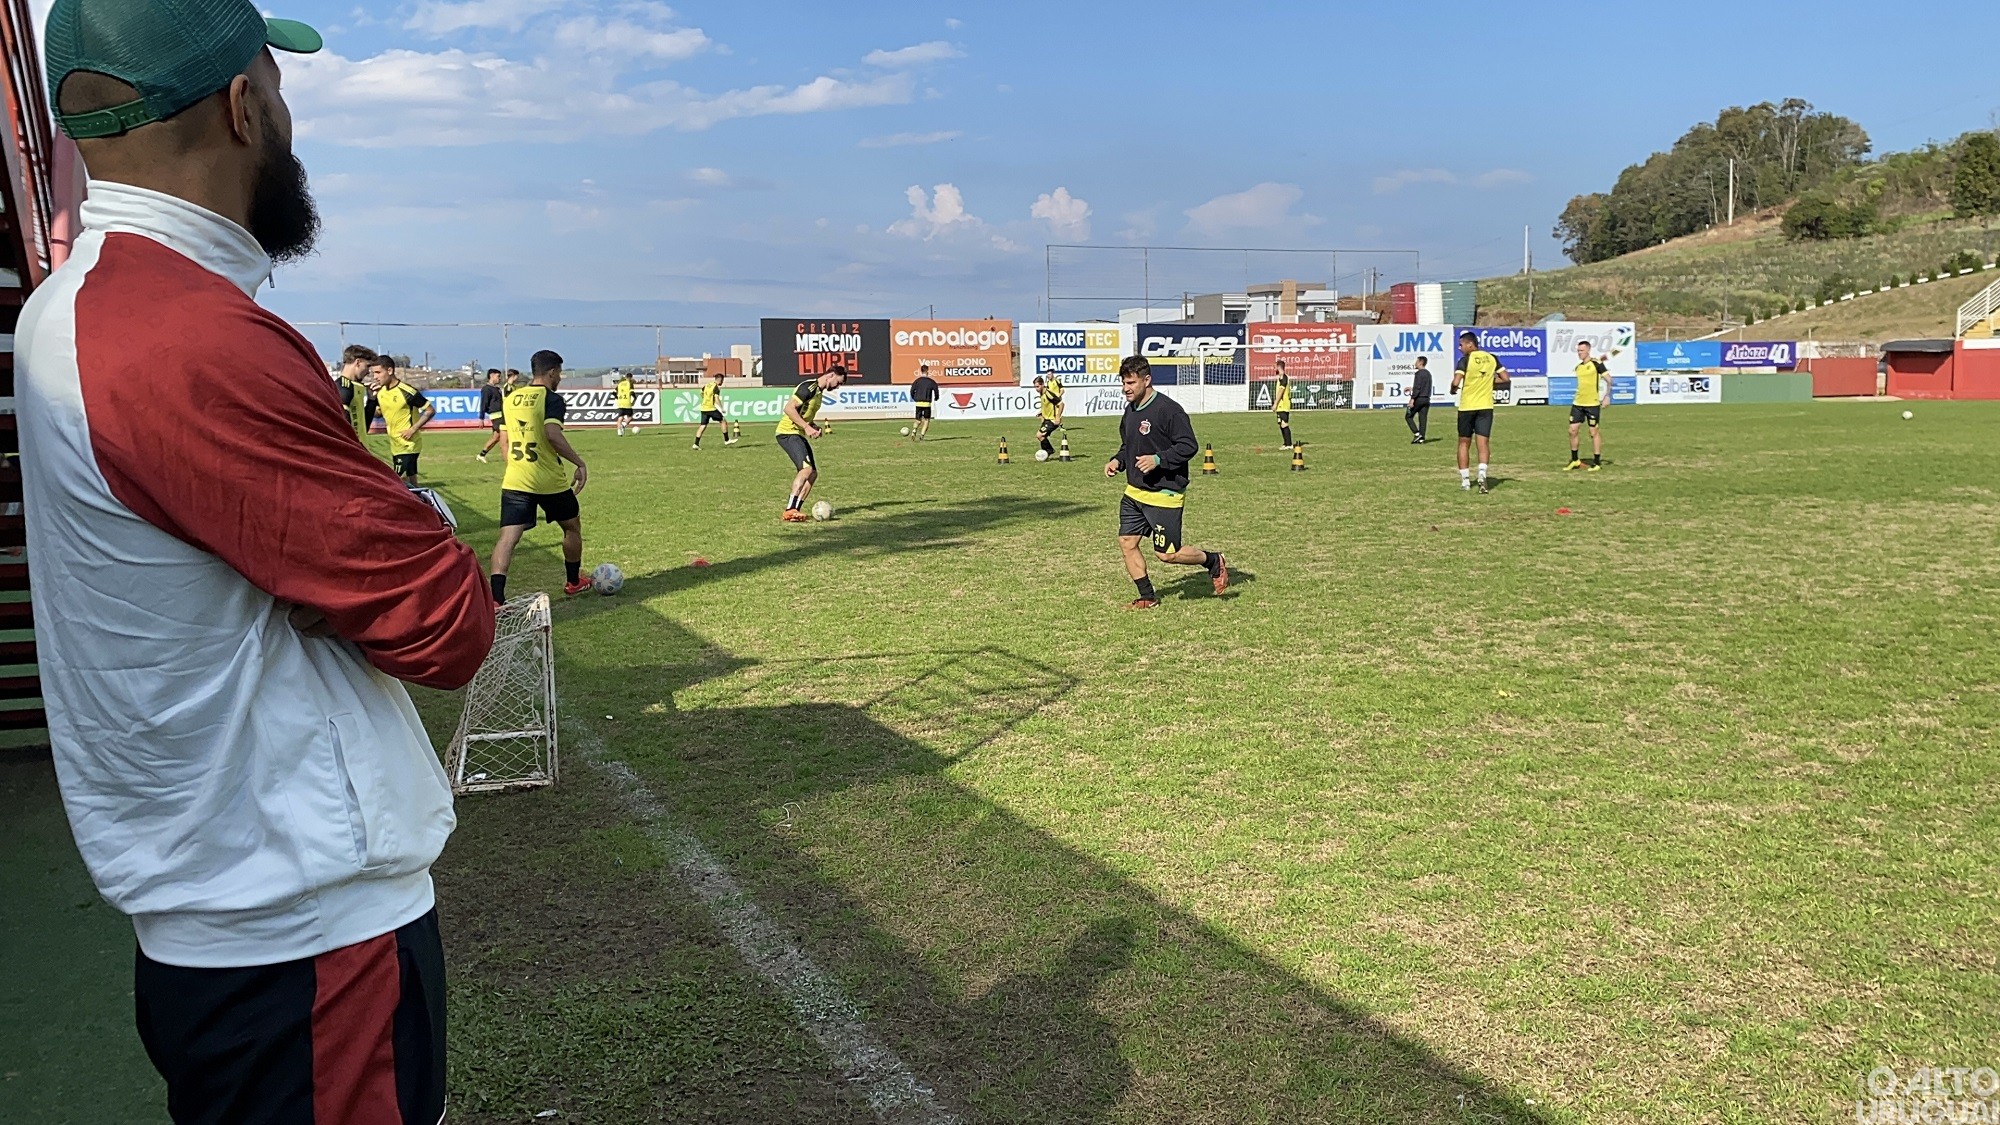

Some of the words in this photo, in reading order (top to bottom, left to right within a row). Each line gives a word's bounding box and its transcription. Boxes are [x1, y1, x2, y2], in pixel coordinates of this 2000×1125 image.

[797, 323, 860, 334] CRELUZ
[796, 333, 862, 352] MERCADO
[1253, 333, 1348, 353] Barril
[1393, 332, 1443, 352] JMX
[1276, 355, 1300, 363] Ferro
[1313, 354, 1331, 364] Aço
[1727, 344, 1767, 361] Arbaza
[918, 358, 940, 366] Vem
[942, 359, 955, 367] ser
[957, 358, 986, 366] DONO
[945, 367, 992, 376] NEGÓCIO!
[980, 391, 1042, 411] vitrola
[511, 441, 538, 463] 55
[1154, 534, 1166, 547] 39
